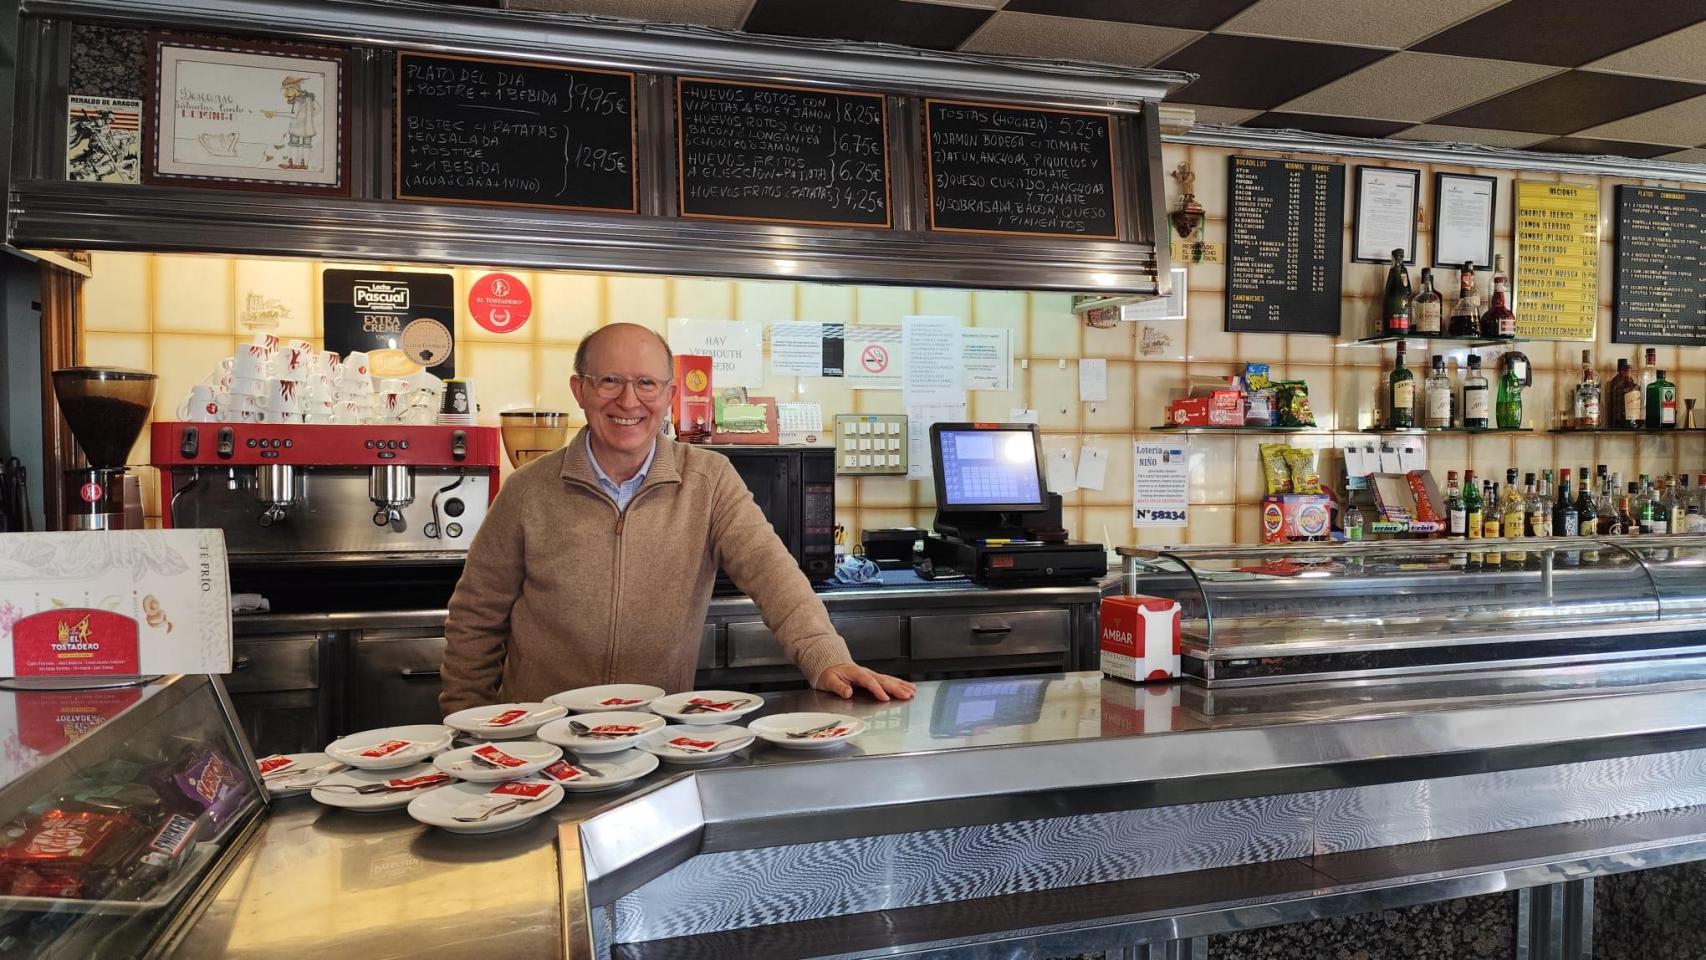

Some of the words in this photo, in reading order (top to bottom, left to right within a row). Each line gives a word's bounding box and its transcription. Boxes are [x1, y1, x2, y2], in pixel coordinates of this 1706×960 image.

[408, 65, 454, 82] PLATO
[462, 69, 488, 85] DEL
[498, 72, 525, 86] DIA
[70, 97, 101, 105] HERALDO
[418, 83, 475, 99] POSTRE
[507, 88, 557, 106] BEBIDA
[754, 92, 796, 106] ROTOS
[802, 97, 826, 107] CON
[685, 100, 738, 113] VIRUTAS
[939, 108, 989, 122] TOSTAS
[408, 116, 464, 131] BISTEC
[494, 120, 557, 139] PATATAS
[747, 116, 786, 131] ROTOS
[689, 124, 734, 136] BACON
[749, 130, 820, 145] LONGANIZA
[421, 144, 482, 158] POSTRE
[983, 134, 1024, 148] BODEGA
[1046, 139, 1092, 154] TOMATE
[441, 160, 500, 175] BEBIDA
[689, 153, 745, 167] HUEVOS
[754, 155, 806, 169] FRITOS
[1034, 154, 1086, 169] PIQUILLOS
[1024, 167, 1070, 179] TOMATE
[690, 185, 740, 198] HUEVOS
[743, 185, 781, 198] FRITOS
[1037, 193, 1088, 205] TOMATE
[1062, 207, 1106, 219] QUESO
[1010, 215, 1086, 232] PIMIENTOS
[357, 290, 405, 303] Pascual
[364, 315, 400, 325] EXTRA
[363, 323, 401, 333] CREME
[705, 335, 728, 346] HAY
[1139, 456, 1157, 467] NIÑO
[69, 635, 80, 643] EL
[1103, 628, 1134, 646] AMBAR
[51, 643, 100, 651] TOSTADERO
[153, 813, 192, 853] SNICKERS
